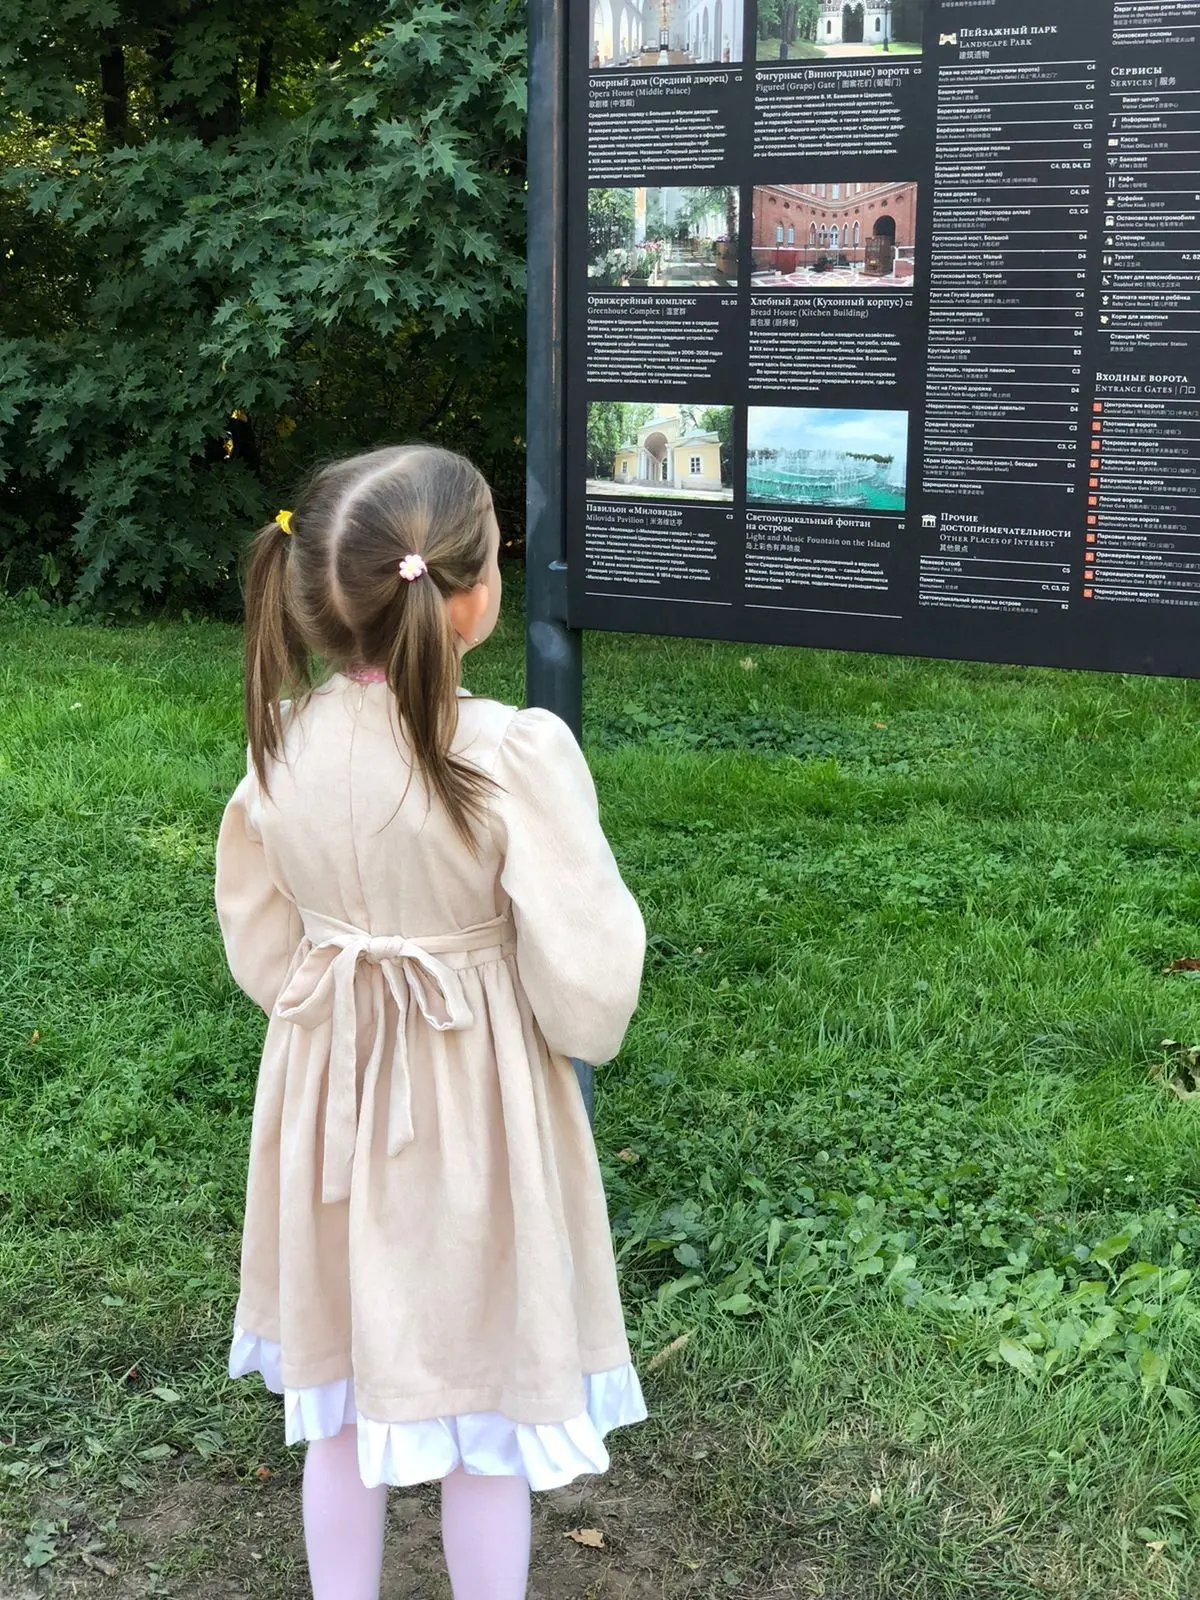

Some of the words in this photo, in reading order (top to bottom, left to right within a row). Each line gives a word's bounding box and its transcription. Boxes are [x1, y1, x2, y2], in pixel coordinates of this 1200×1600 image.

[960, 26, 1027, 37] ПЕЙЗАЖНЫЙ
[959, 39, 1007, 48] LANDSCAPE
[755, 71, 802, 82] Фигурные
[804, 68, 874, 80] (Виноградные)
[877, 68, 909, 77] ворота
[1111, 66, 1161, 75] СЕРВИСЫ
[589, 78, 628, 89] Оперный
[649, 75, 691, 87] (Средний
[693, 74, 728, 85] дворец)
[1110, 78, 1152, 86] SERVICES
[756, 83, 784, 93] Figured
[786, 81, 815, 91] (Grape)
[589, 90, 610, 99] Opera
[635, 87, 663, 96] (Middle
[665, 87, 690, 95] Palace)
[587, 296, 653, 306] Оранжерейный
[751, 297, 790, 305] Хлебный
[813, 297, 864, 308] (Кухонный
[867, 298, 903, 308] корпус)
[629, 307, 659, 316] Complex
[833, 309, 868, 318] Building)
[1096, 372, 1145, 382] ВХОДНЫЕ
[1149, 374, 1187, 382] ВОРОТА
[1095, 384, 1141, 392] ENTRANCE
[1144, 385, 1172, 393] GATES
[586, 503, 626, 513] Павильон
[628, 506, 682, 516] «Миловида»
[617, 515, 644, 523] Pavilion
[746, 513, 833, 525] Светомузыкальный
[835, 518, 870, 529] фонтан
[941, 512, 978, 522] ПРОЧИЕ
[758, 524, 792, 533] острове
[940, 524, 1070, 537] ДОСТОПРИМЕЧАТЕЛЬНОСТИ
[746, 532, 765, 542] Light
[767, 533, 780, 541] and
[806, 536, 839, 544] Fountain
[867, 539, 890, 547] Island
[939, 534, 968, 542] OTHER
[1014, 538, 1054, 547] INTEREST
